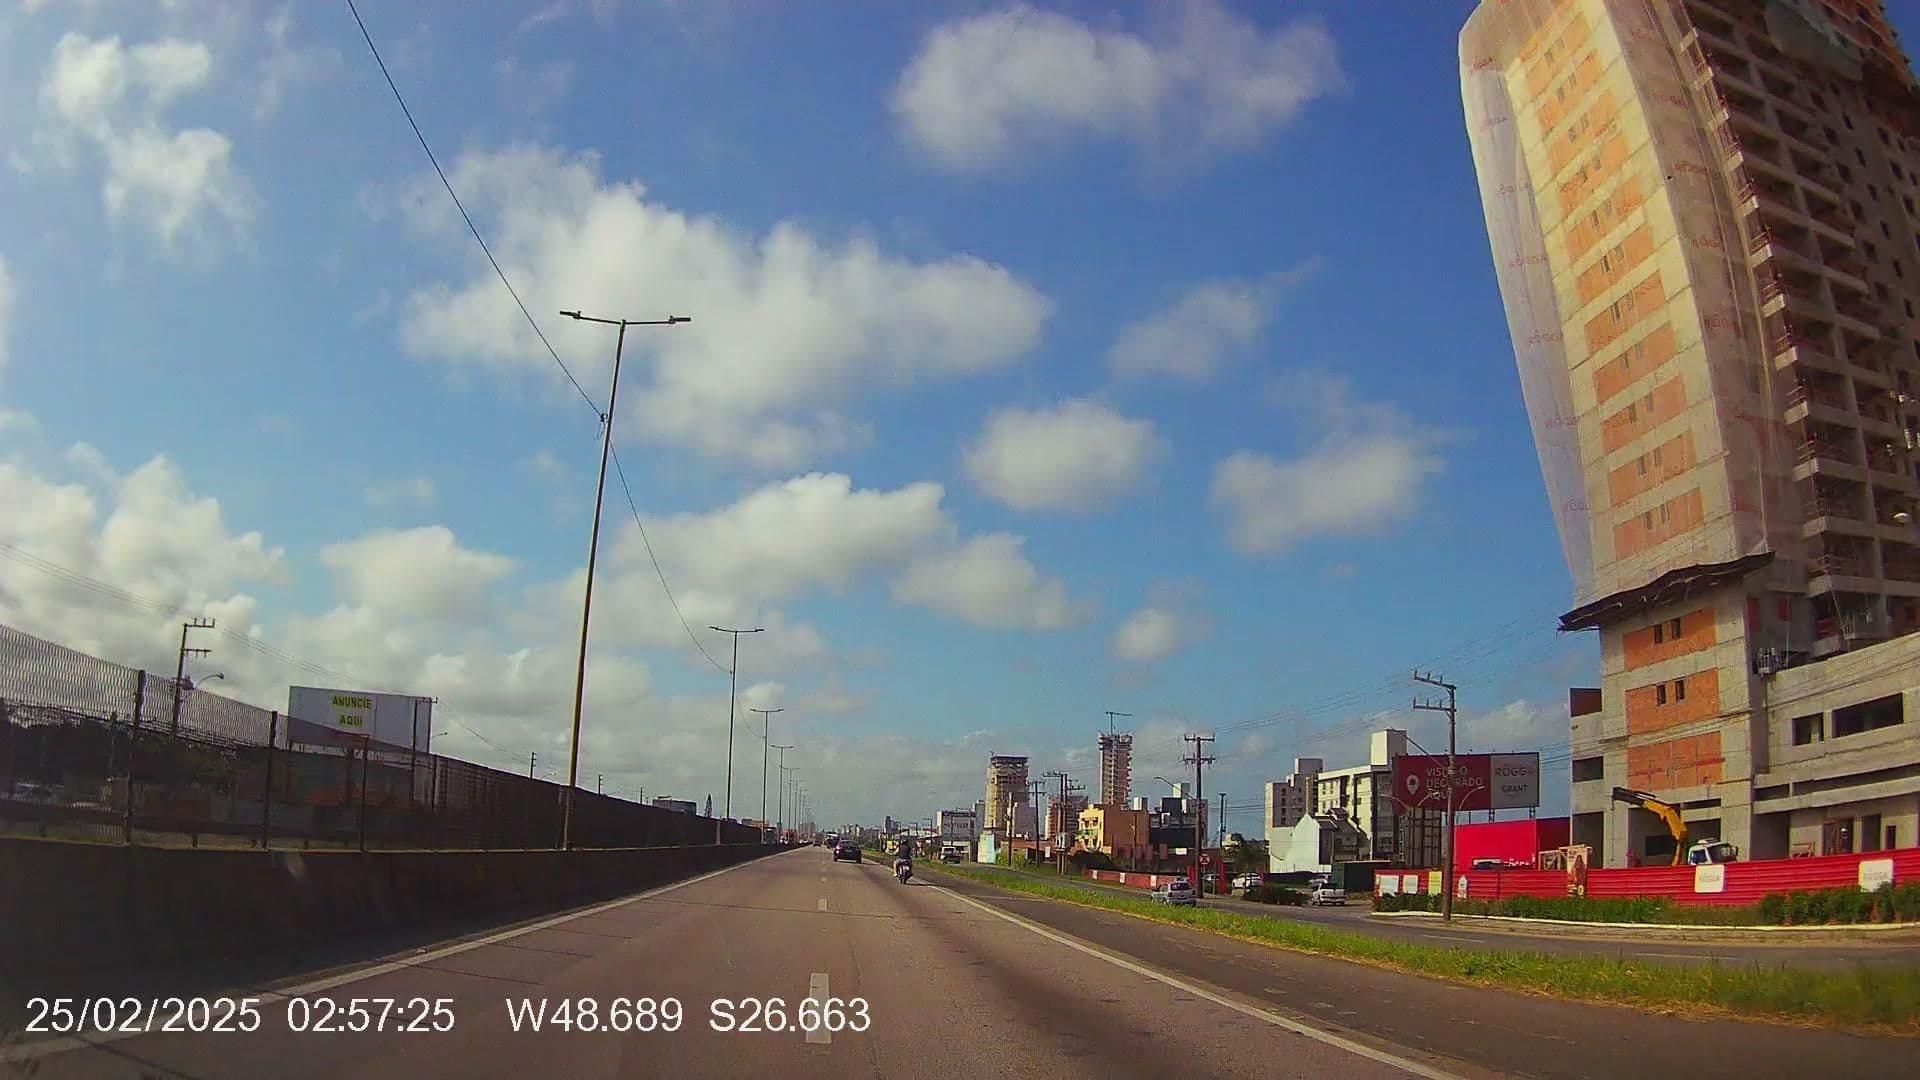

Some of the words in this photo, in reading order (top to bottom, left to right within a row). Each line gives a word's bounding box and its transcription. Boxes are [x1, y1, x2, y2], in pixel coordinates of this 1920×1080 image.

[332, 696, 372, 709] ANUNCIE
[340, 715, 363, 726] AQUI
[1426, 776, 1483, 789] DECRADO
[1502, 784, 1528, 793] GRANT
